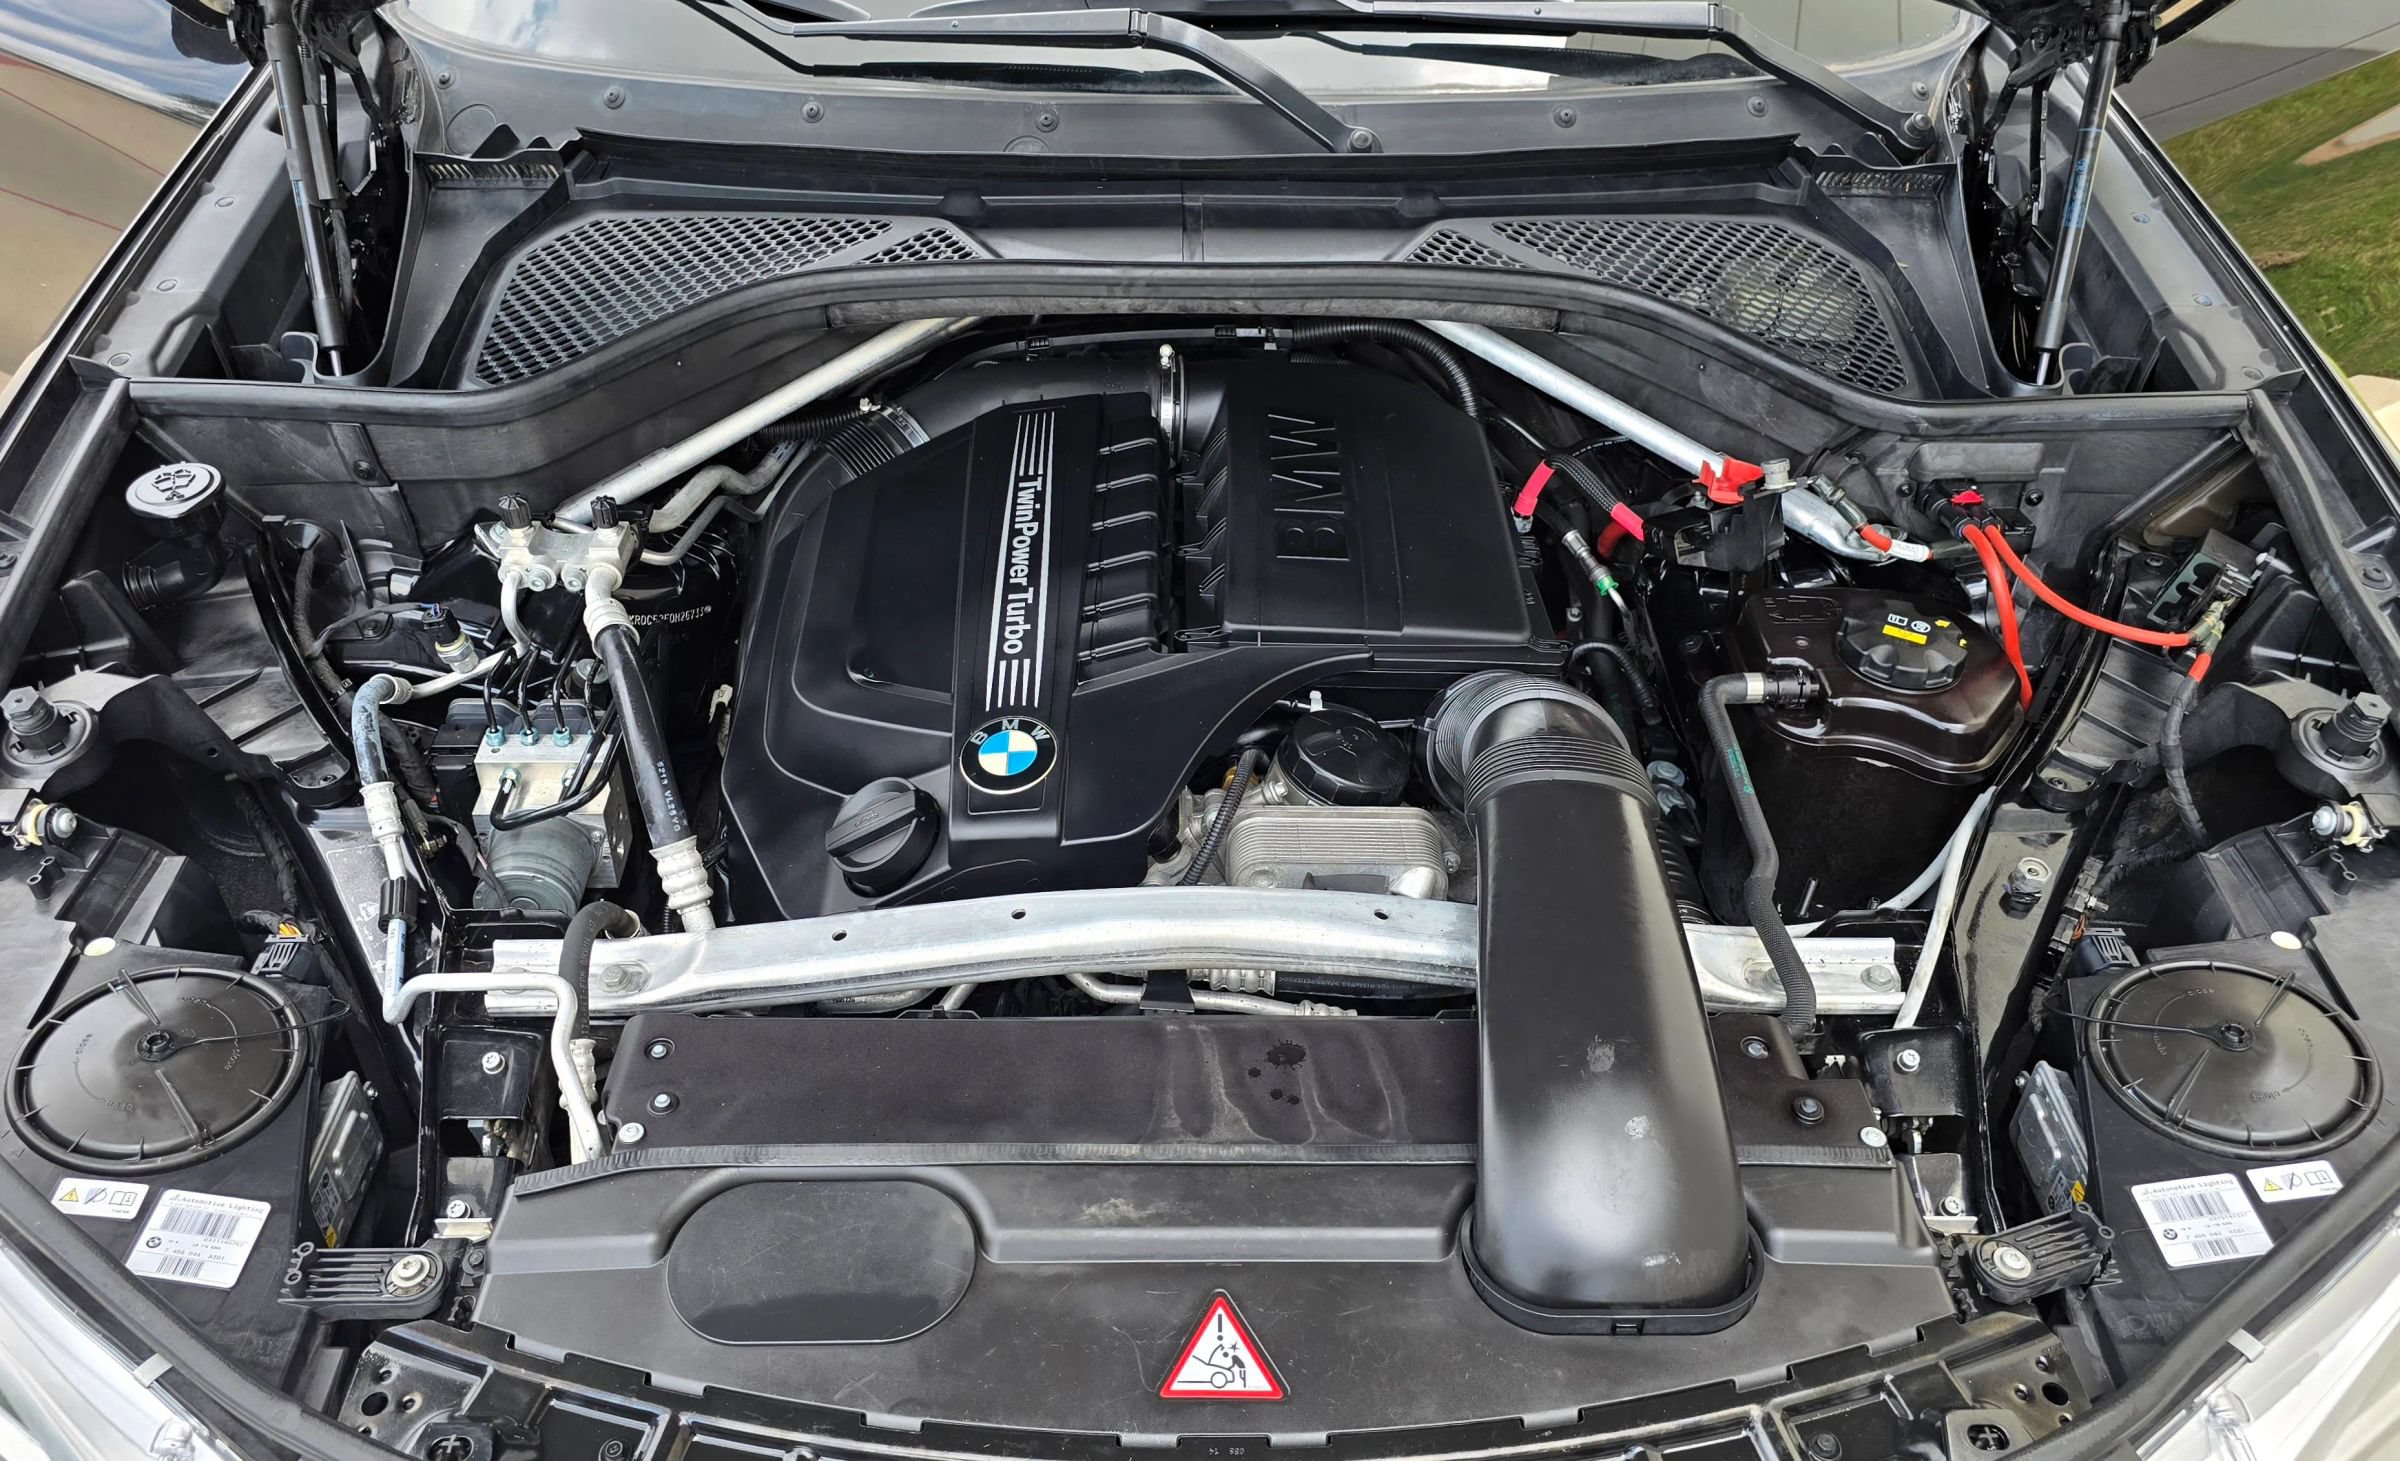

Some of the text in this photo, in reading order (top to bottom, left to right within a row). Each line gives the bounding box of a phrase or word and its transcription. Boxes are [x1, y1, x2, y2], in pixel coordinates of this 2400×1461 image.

[1267, 413, 1351, 562] BMW
[1002, 476, 1043, 654] TwinPower Turbo
[970, 719, 1050, 745] BMW
[182, 1197, 225, 1207] Automotive
[229, 1203, 264, 1214] Lighting
